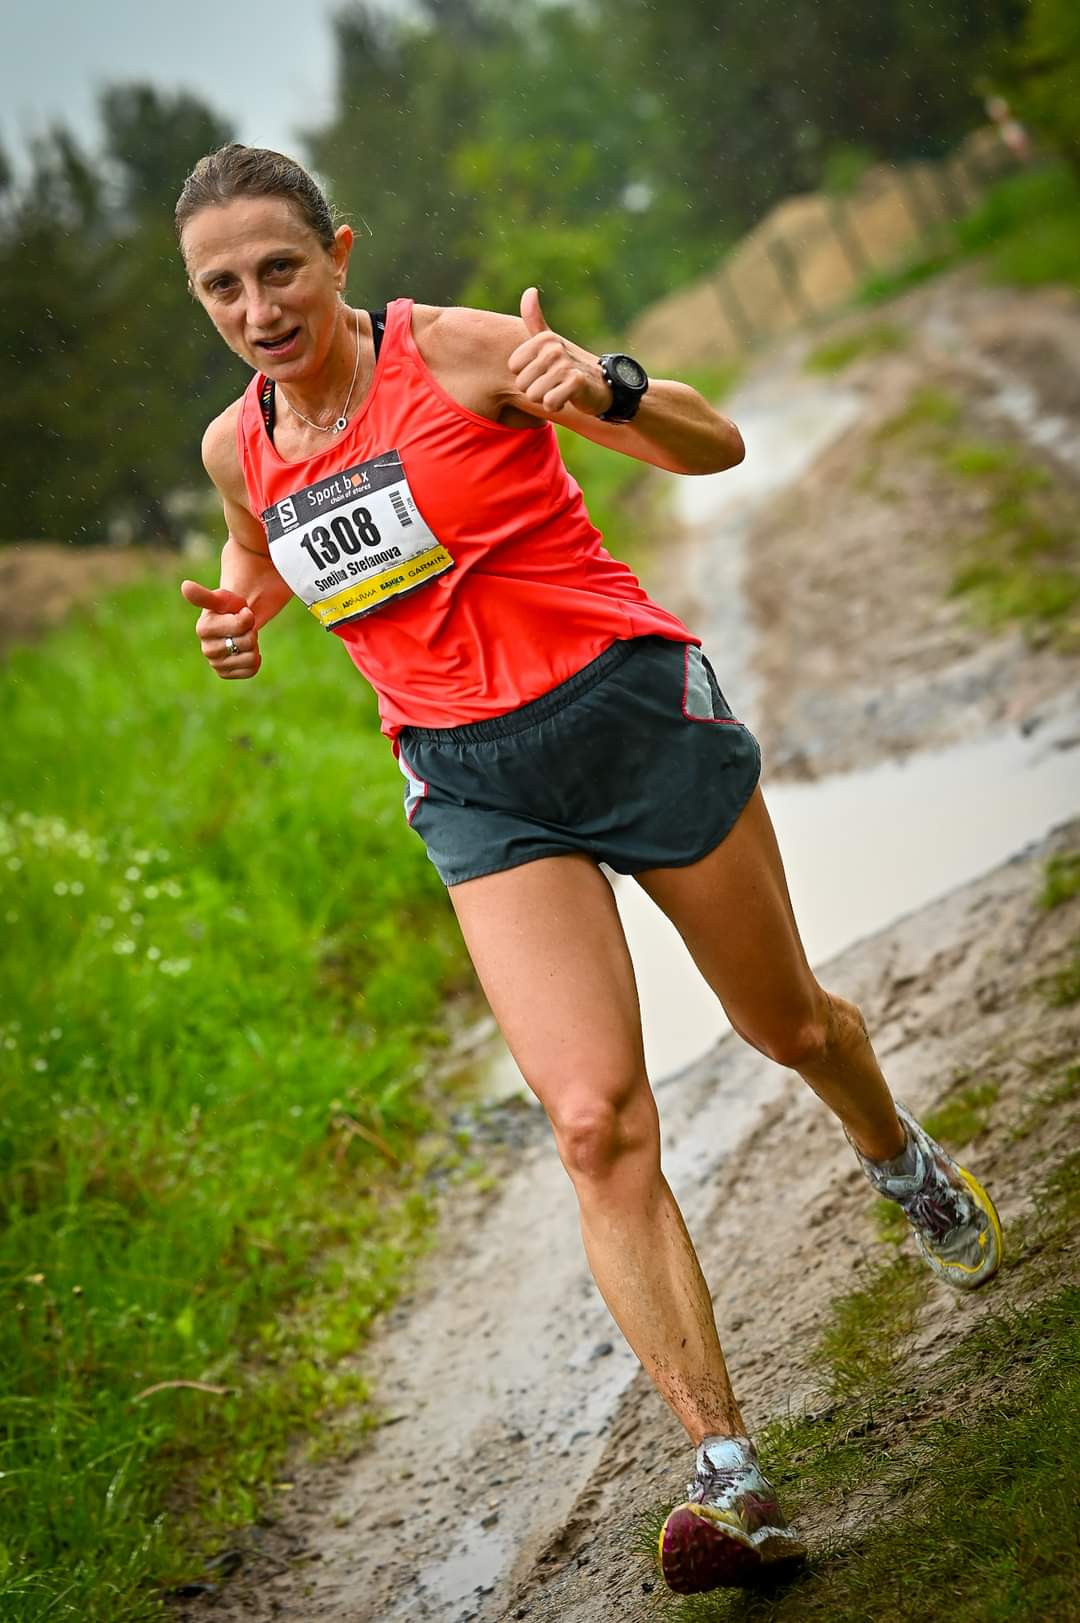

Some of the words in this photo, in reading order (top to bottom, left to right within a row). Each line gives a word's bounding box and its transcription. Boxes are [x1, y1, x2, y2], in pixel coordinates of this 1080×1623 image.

[307, 481, 342, 506] Sport
[330, 492, 345, 505] chain
[300, 507, 381, 572] 1308
[346, 546, 402, 576] Stefanova
[408, 553, 446, 577] GARMIN
